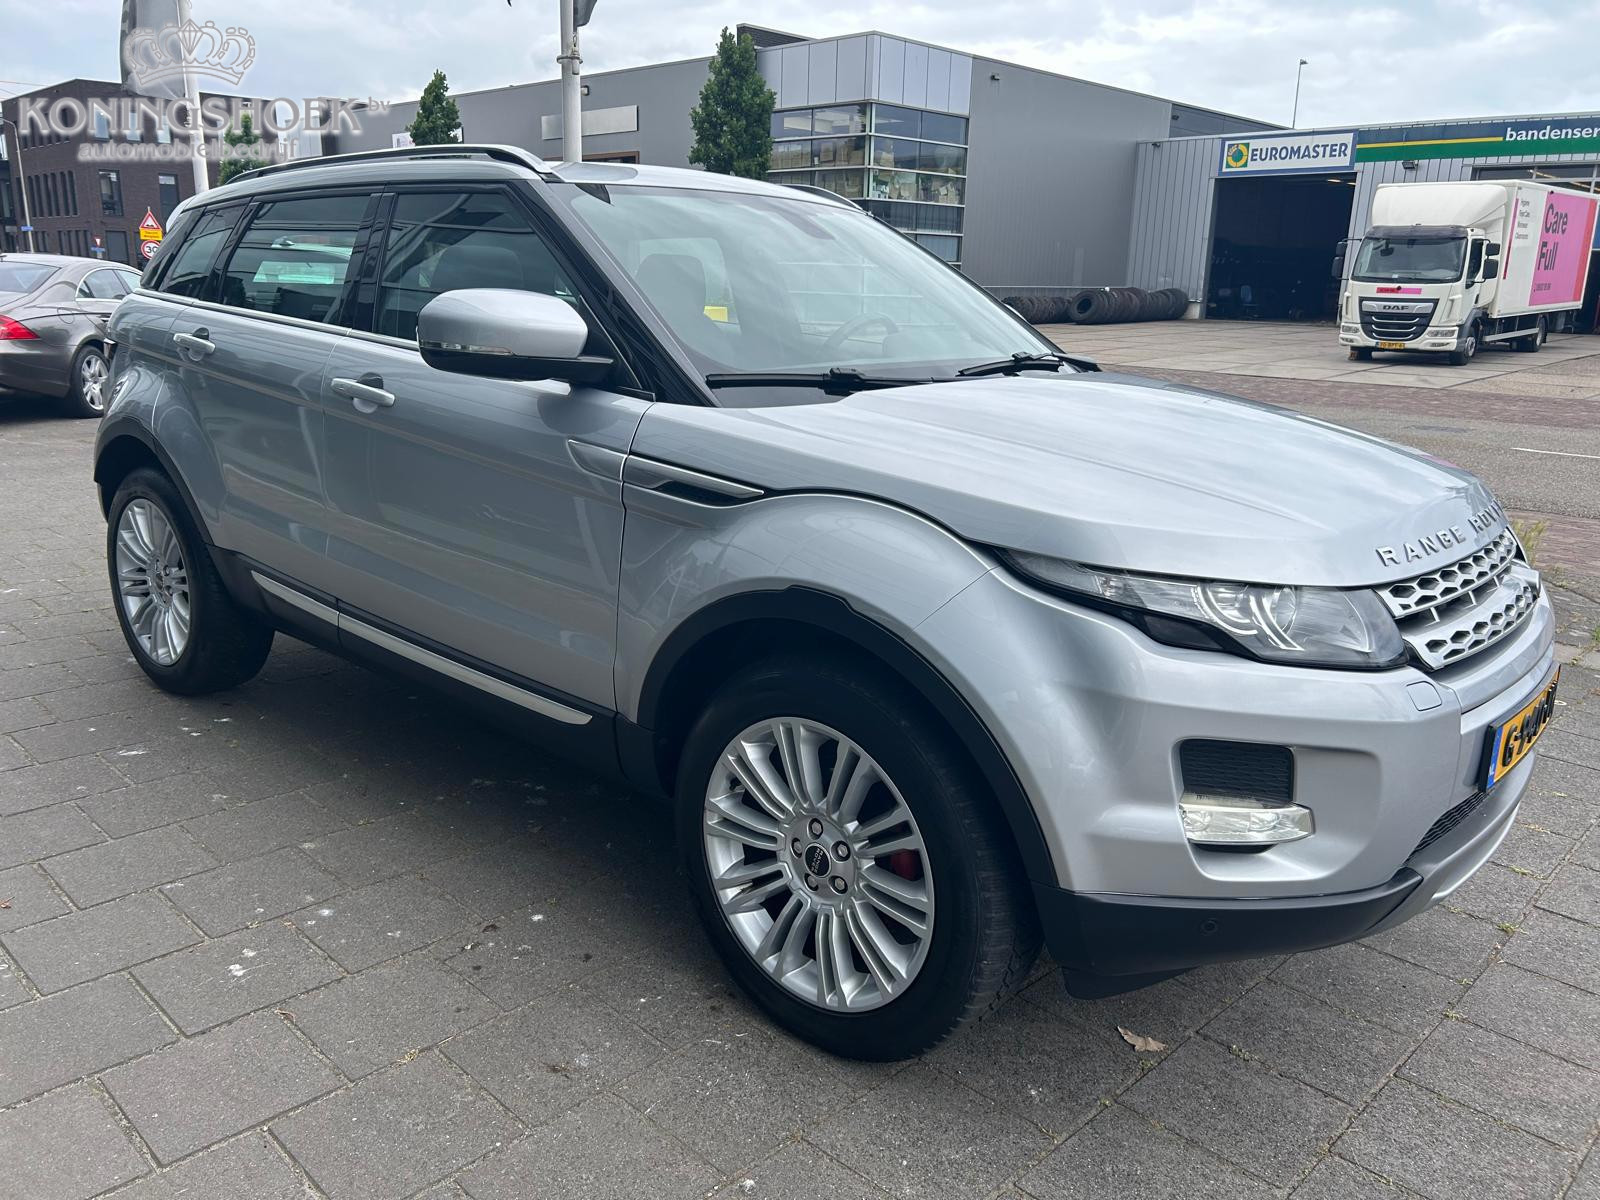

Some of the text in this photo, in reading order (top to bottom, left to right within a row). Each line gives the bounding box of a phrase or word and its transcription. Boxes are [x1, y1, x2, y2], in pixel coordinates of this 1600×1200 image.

[1250, 142, 1349, 162] EUROMASTER
[1545, 203, 1568, 235] Care
[1537, 241, 1559, 271] Full
[1376, 525, 1466, 567] RANGE
